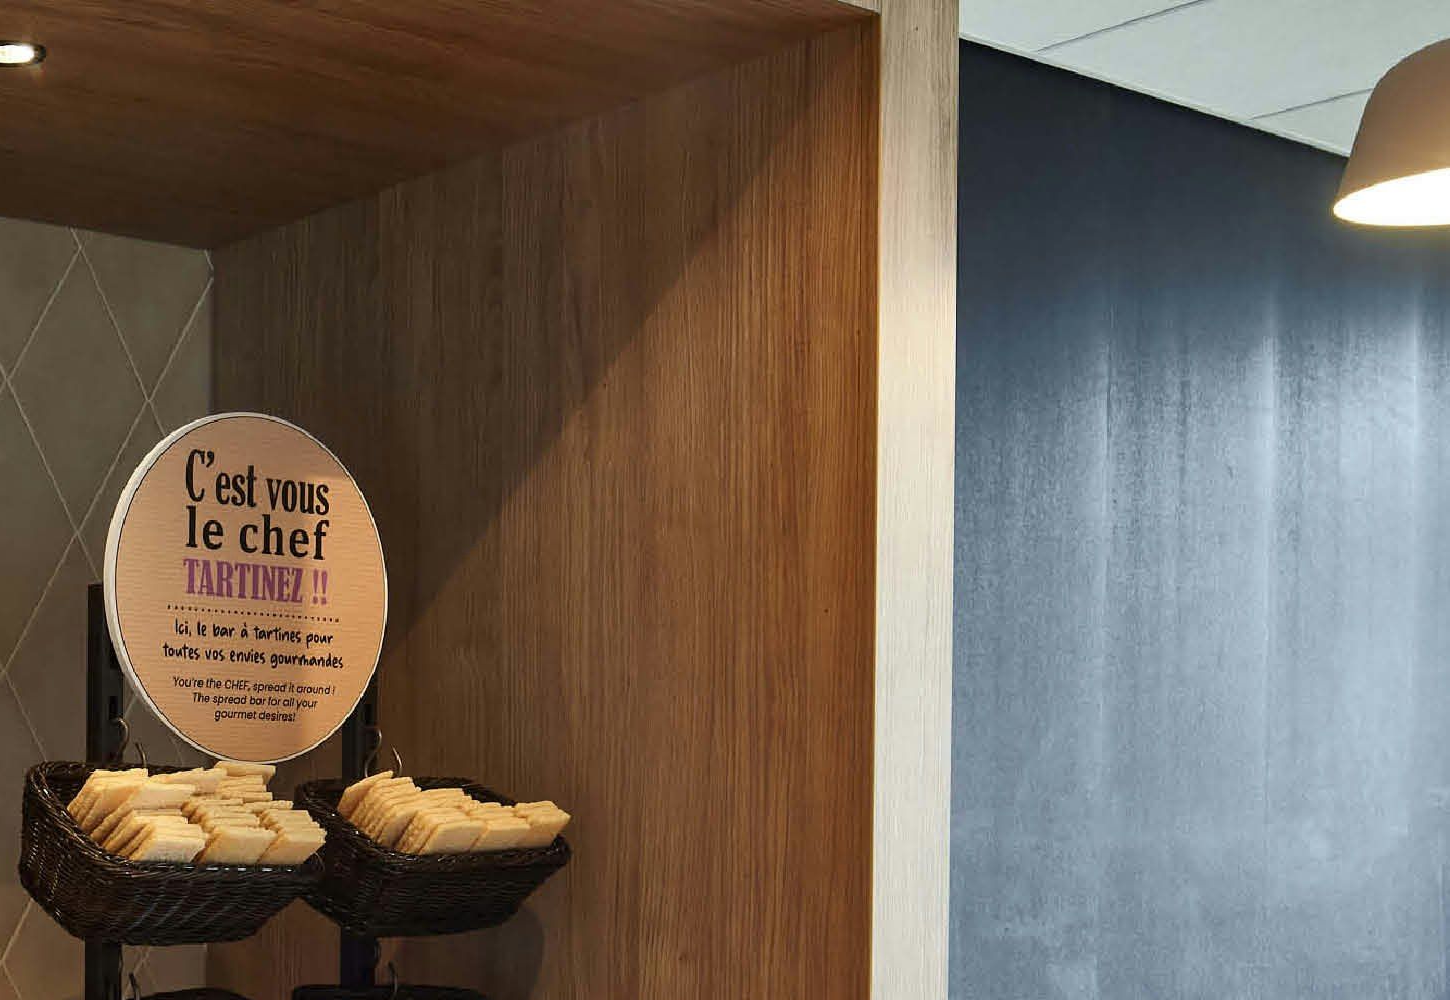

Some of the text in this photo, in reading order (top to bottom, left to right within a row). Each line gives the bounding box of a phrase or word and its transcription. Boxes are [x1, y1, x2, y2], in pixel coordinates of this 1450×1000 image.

[185, 449, 330, 516] C'est vous
[185, 505, 330, 561] le chef
[183, 558, 328, 605] TARTINEZ !!
[175, 618, 334, 649] Ici, le bar à tartines pour
[163, 642, 344, 669] toutes vos envies gourmandes
[206, 677, 222, 689] the
[224, 679, 251, 691] CHEF,
[253, 682, 287, 693] spread
[288, 682, 295, 693] it
[193, 692, 318, 711] The spread bar for all your
[214, 710, 257, 722] gourmet
